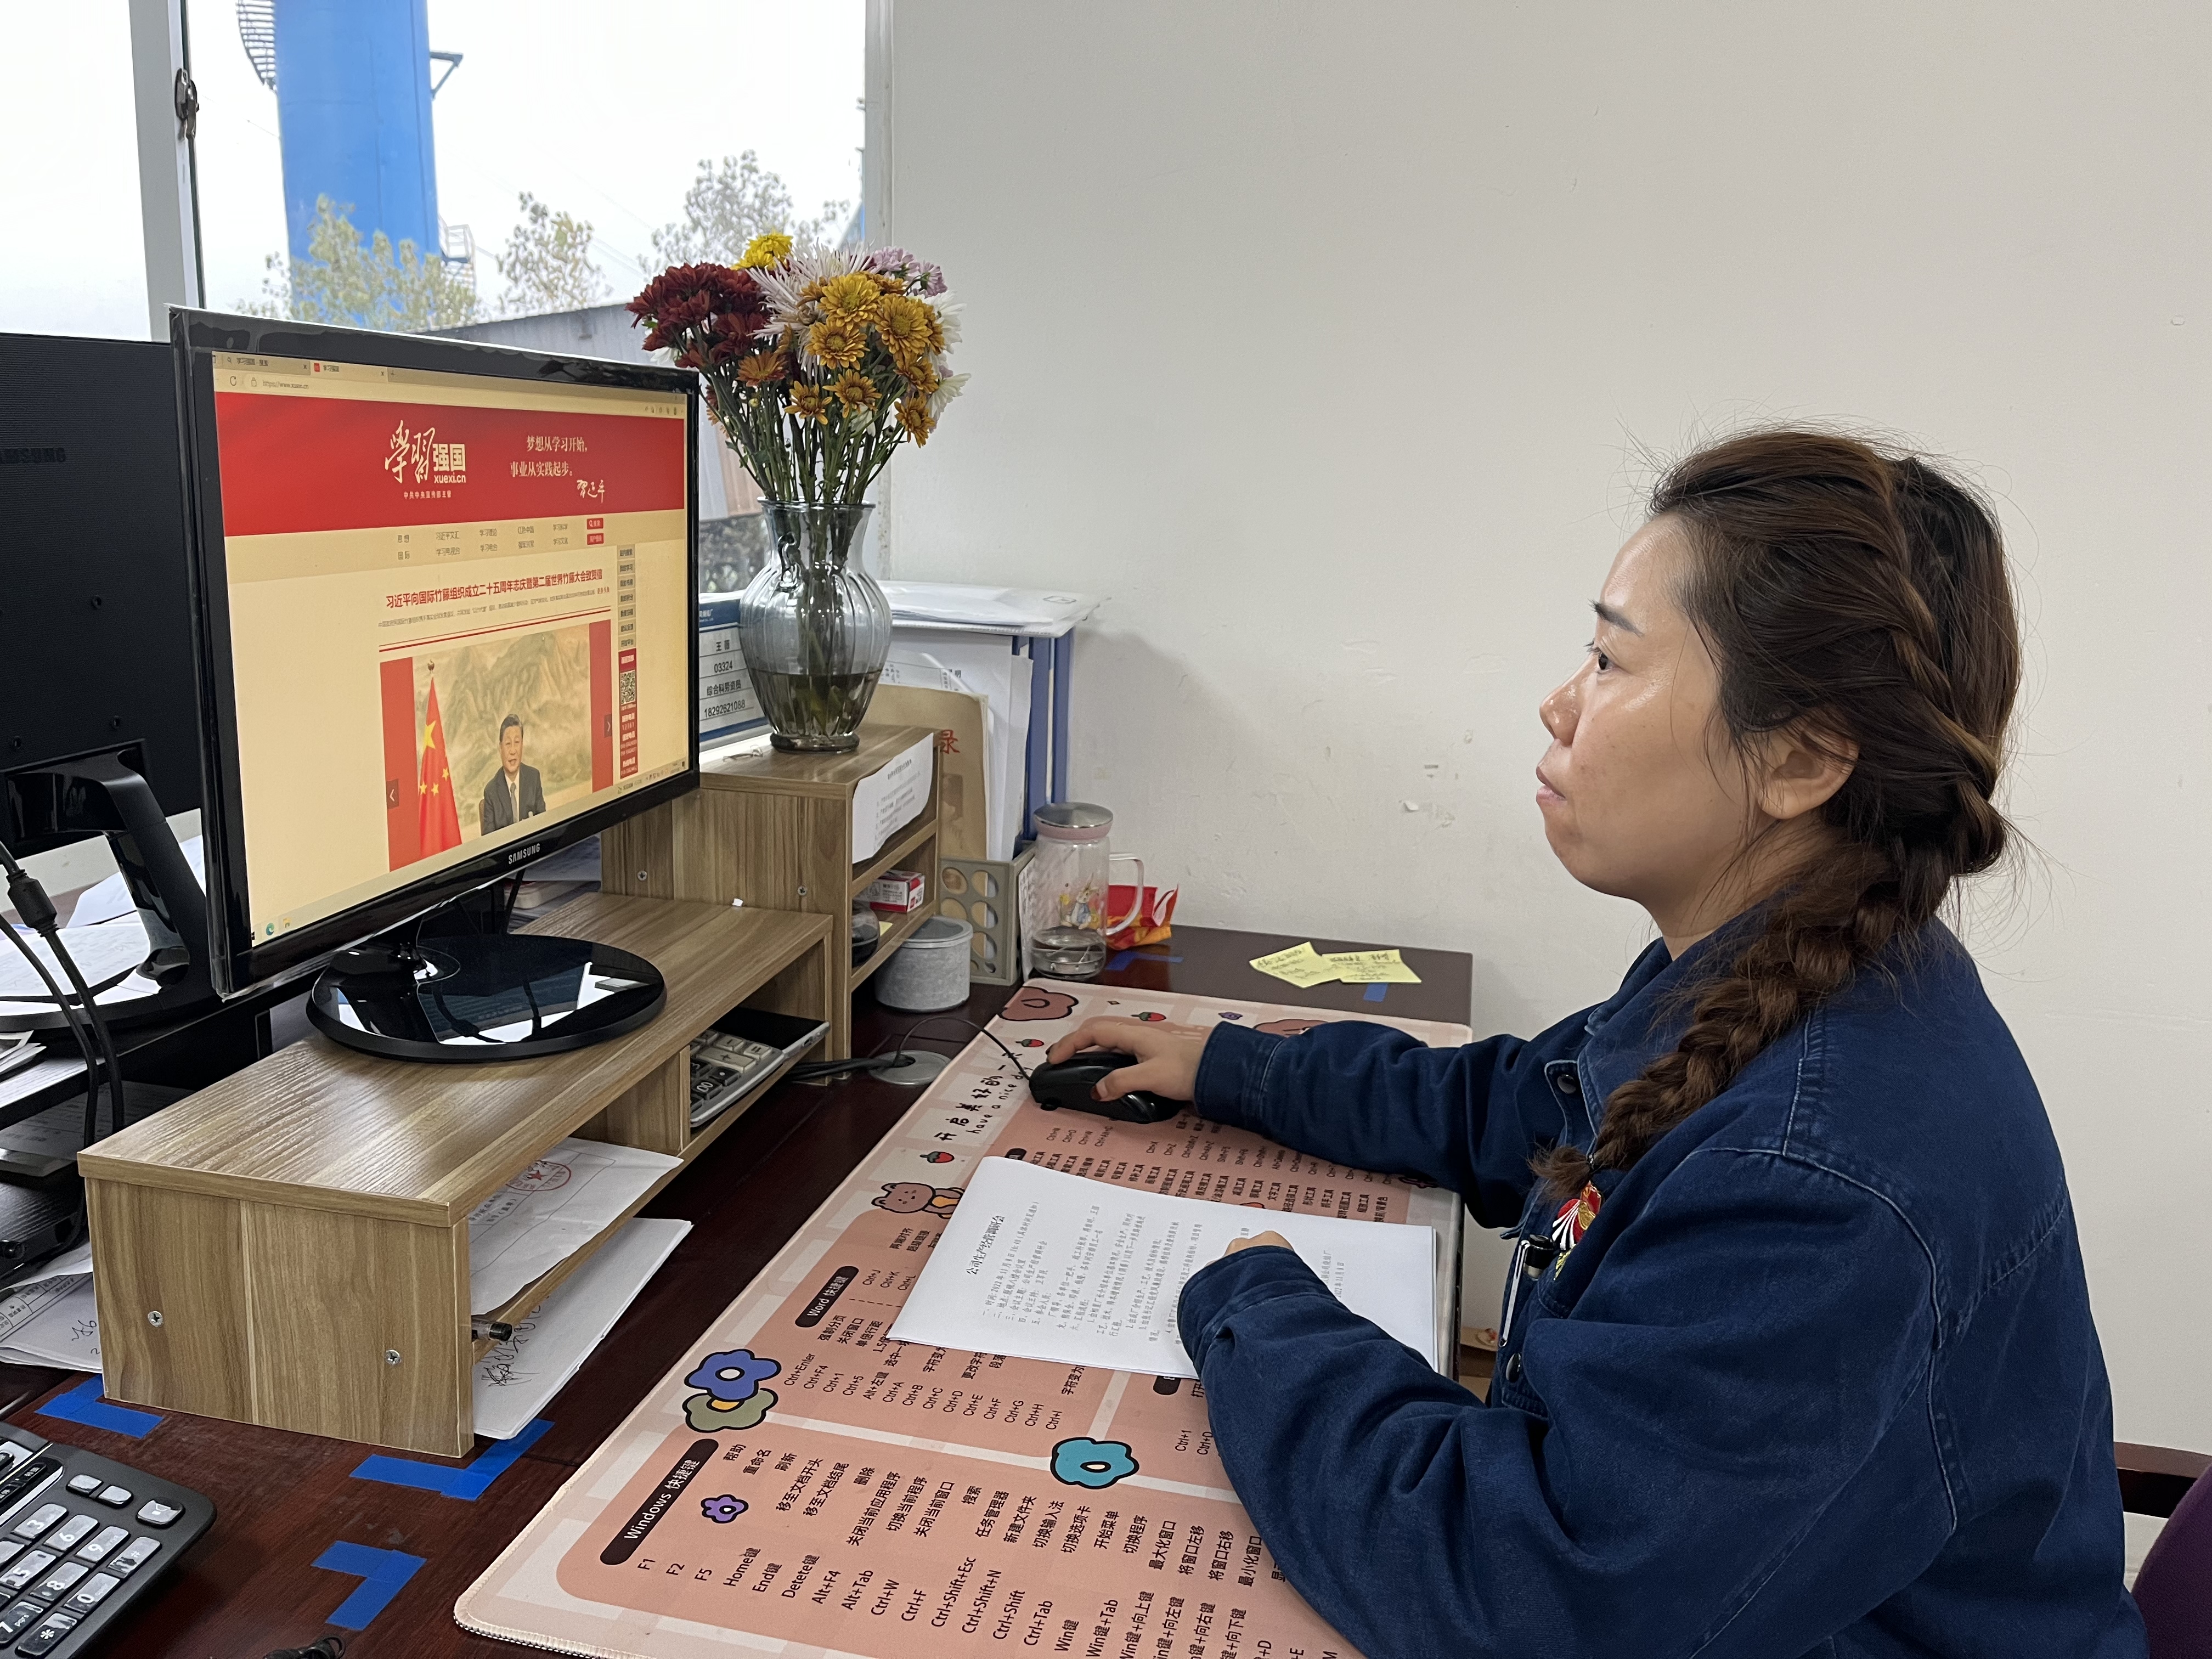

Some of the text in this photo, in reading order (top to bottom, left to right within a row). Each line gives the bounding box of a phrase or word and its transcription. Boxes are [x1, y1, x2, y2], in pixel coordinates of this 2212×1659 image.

[434, 473, 466, 484] xuexi.cn
[714, 660, 733, 674] 03324
[508, 843, 541, 865] SAMSUNG
[965, 1114, 993, 1135] have
[998, 1083, 1017, 1100] nice
[806, 1298, 830, 1317] Word
[836, 1317, 865, 1345] 关闭窗口
[855, 1320, 884, 1347] 单倍行距
[783, 1353, 816, 1386] Ctrl+Enter
[803, 1365, 829, 1389] Ctrl+F4
[822, 1373, 844, 1392] Ctrl+1
[842, 1375, 864, 1396] Ctrl+5
[882, 1382, 905, 1403] Ctrl+A
[902, 1384, 923, 1406] Ctrl+B
[922, 1387, 944, 1409] Ctrl+C
[943, 1390, 963, 1413] Ctrl+D
[963, 1393, 984, 1416] Ctrl+E
[983, 1397, 1002, 1420] Ctrl+F
[1004, 1400, 1024, 1423] Ctrl+G
[1024, 1403, 1045, 1426] Ctrl+H
[723, 1444, 746, 1462] 帮助
[1175, 1430, 1192, 1452] Ctrl+1
[742, 1449, 772, 1475] 重命名
[774, 1452, 798, 1471] 刷新
[853, 1467, 876, 1486] 删除
[623, 1459, 701, 1539] Windows 快捷键
[775, 1458, 824, 1511] 移至文档开头
[803, 1462, 849, 1516] 移至文档结尾
[961, 1485, 983, 1505] 搜索
[845, 1471, 901, 1547] 关闭当前应用程序
[885, 1476, 928, 1532] 切换当前程序
[913, 1481, 955, 1538] 关闭当前窗口
[974, 1491, 1009, 1537] 任务管理器
[26, 1519, 45, 1530] 3
[1002, 1496, 1037, 1544] 新建文件夹
[1031, 1500, 1065, 1548] 切换输入法
[1060, 1505, 1091, 1553] 切换选项卡
[1093, 1511, 1120, 1550] 开始菜单
[1121, 1515, 1148, 1554] 切换程序
[1148, 1520, 1177, 1571] 最大化窗口
[1177, 1525, 1205, 1576] 将窗口左移
[1207, 1530, 1234, 1581] 将窗口右移
[12, 1566, 30, 1578] 5
[637, 1559, 656, 1570] F1
[665, 1563, 685, 1576] F2
[693, 1568, 712, 1581] F5
[723, 1548, 761, 1587] Home键
[781, 1554, 820, 1599] Detete键
[1238, 1536, 1262, 1587] 最小化窗口
[46, 1580, 66, 1590] 8
[752, 1562, 783, 1593] End键
[811, 1570, 842, 1605] Alt+F4
[840, 1570, 873, 1611] Alt+Tab
[931, 1556, 977, 1627] Ctrl+Shift+Esc
[76, 1593, 95, 1604] 0
[871, 1579, 900, 1616] Ctrl+W
[901, 1589, 927, 1621] Ctrl+F
[962, 1570, 1002, 1634] Ctrl+Shift+N
[992, 1590, 1026, 1640] Ctrl+Shift
[1023, 1600, 1053, 1646] Ctrl+Tab
[1085, 1599, 1119, 1657] Win键+Tab
[1152, 1596, 1185, 1659] in键+向左键
[1053, 1619, 1080, 1651] Win键
